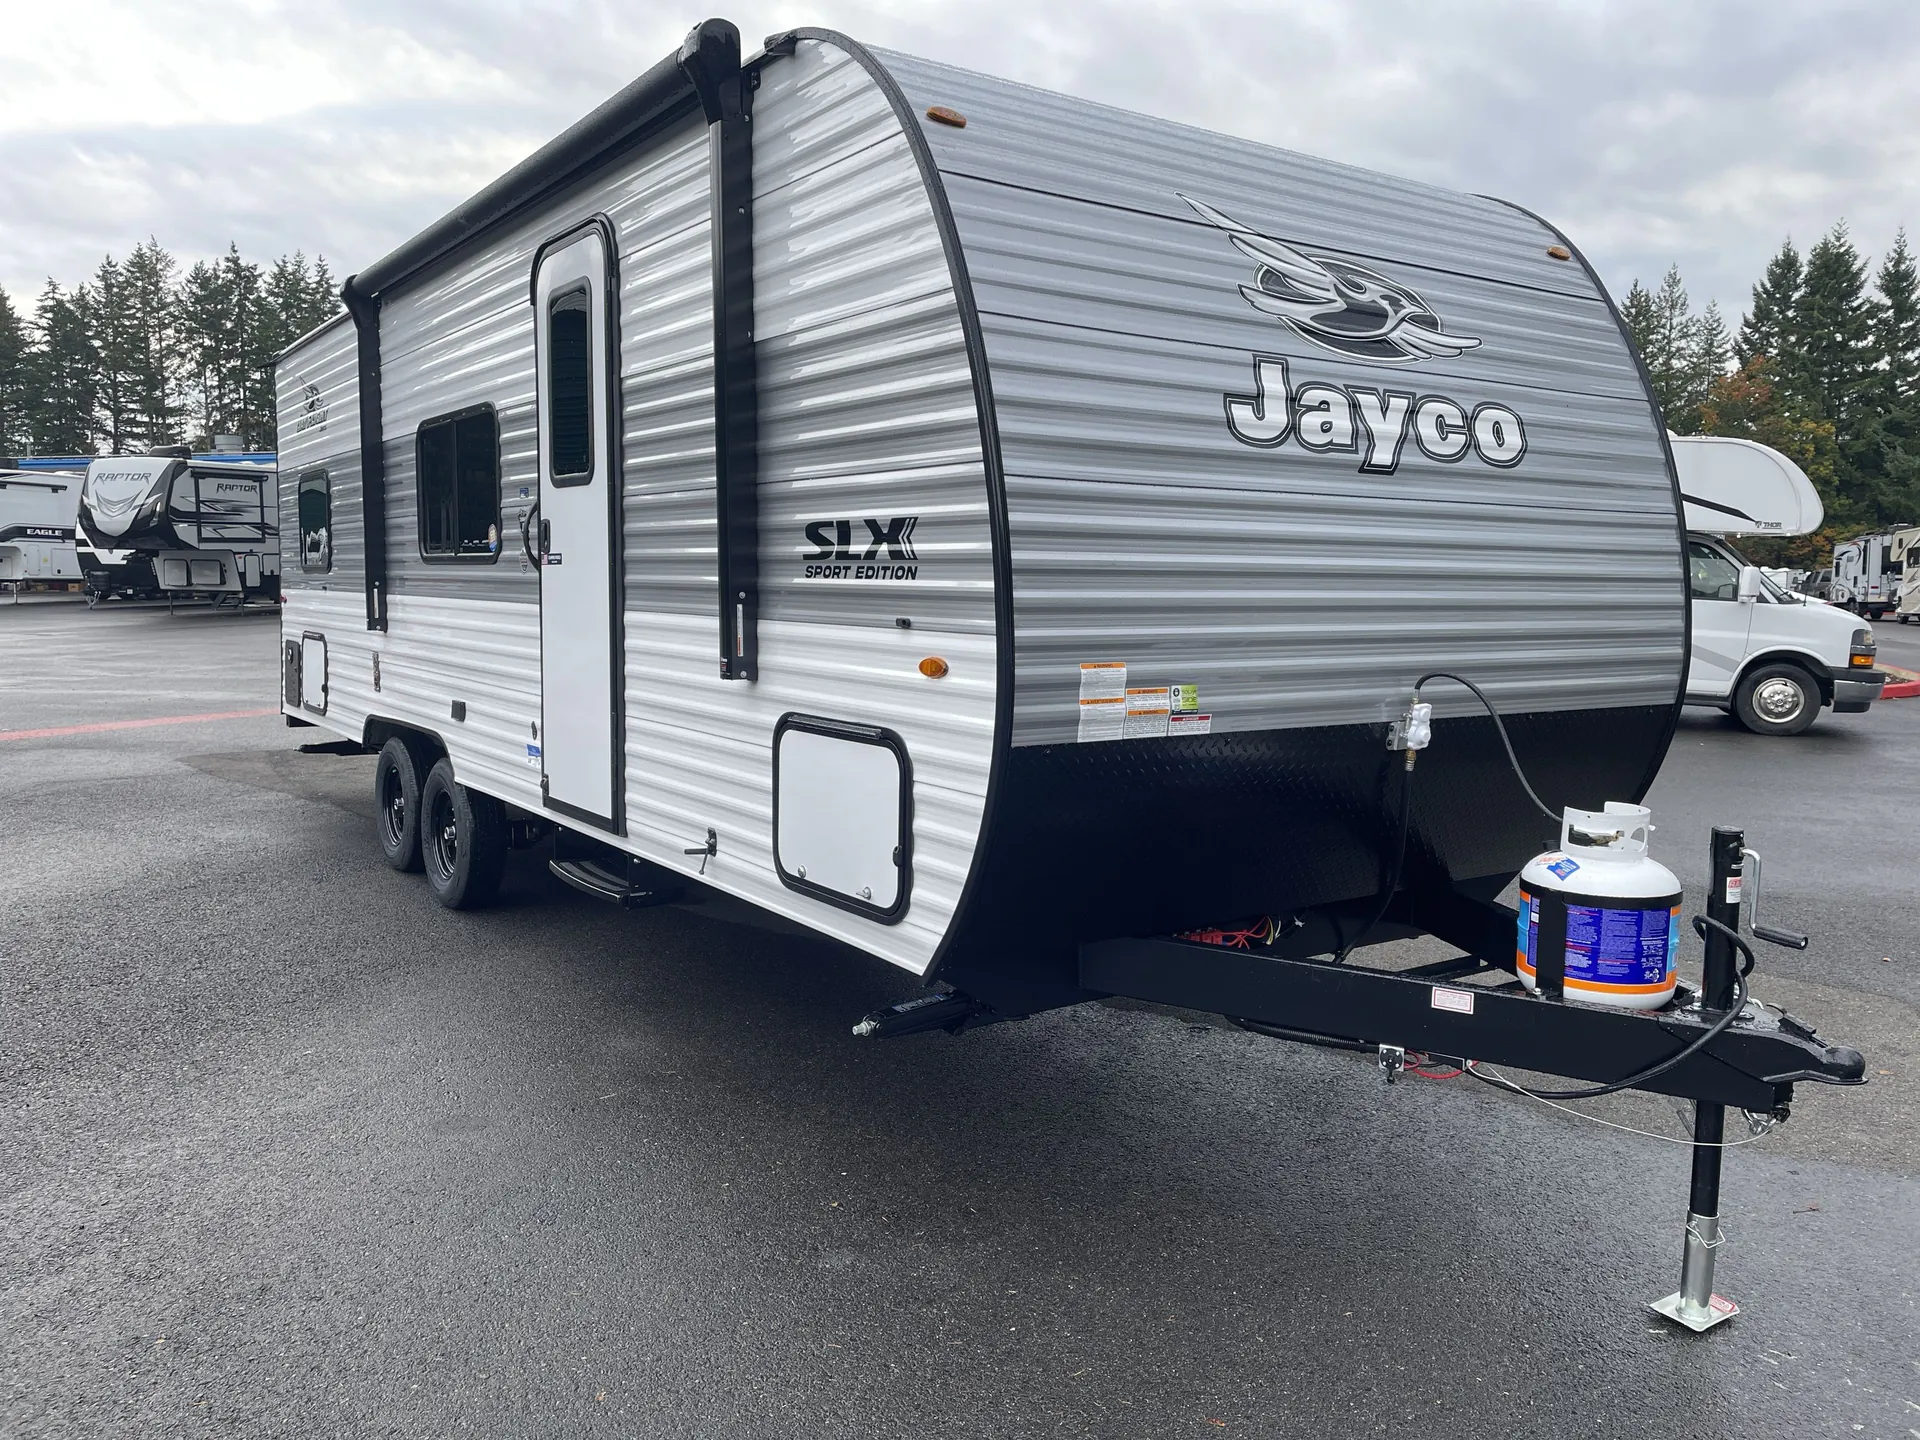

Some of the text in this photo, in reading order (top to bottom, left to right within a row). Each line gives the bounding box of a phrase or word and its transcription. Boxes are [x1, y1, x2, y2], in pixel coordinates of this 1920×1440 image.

[1223, 353, 1528, 475] Jayco
[92, 473, 151, 485] RAPTOR
[216, 483, 258, 495] RAPTOR
[26, 528, 63, 536] EAGLE
[802, 516, 919, 560] SLX
[805, 565, 918, 580] SPORT EDITION
